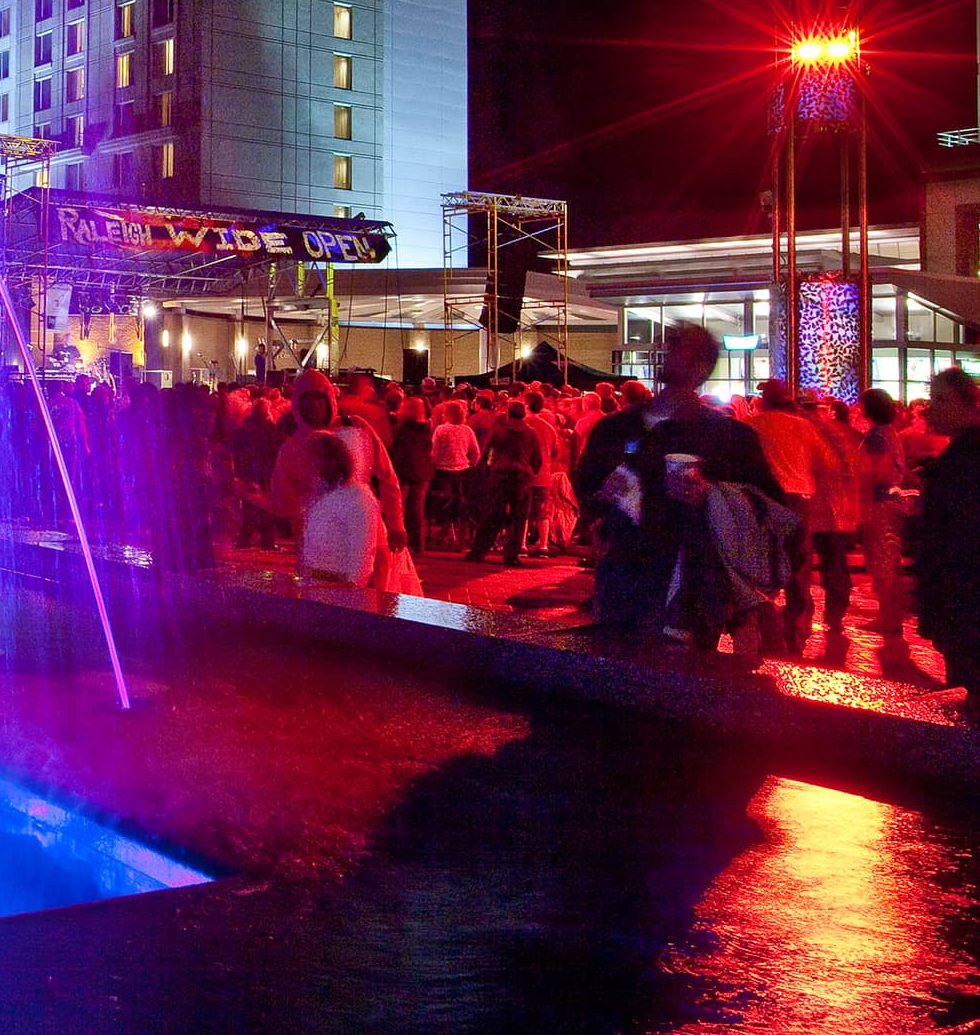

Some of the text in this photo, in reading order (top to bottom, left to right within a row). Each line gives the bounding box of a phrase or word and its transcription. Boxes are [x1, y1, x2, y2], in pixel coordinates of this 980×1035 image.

[56, 207, 377, 261] RALEIGH WIDE OPEN
